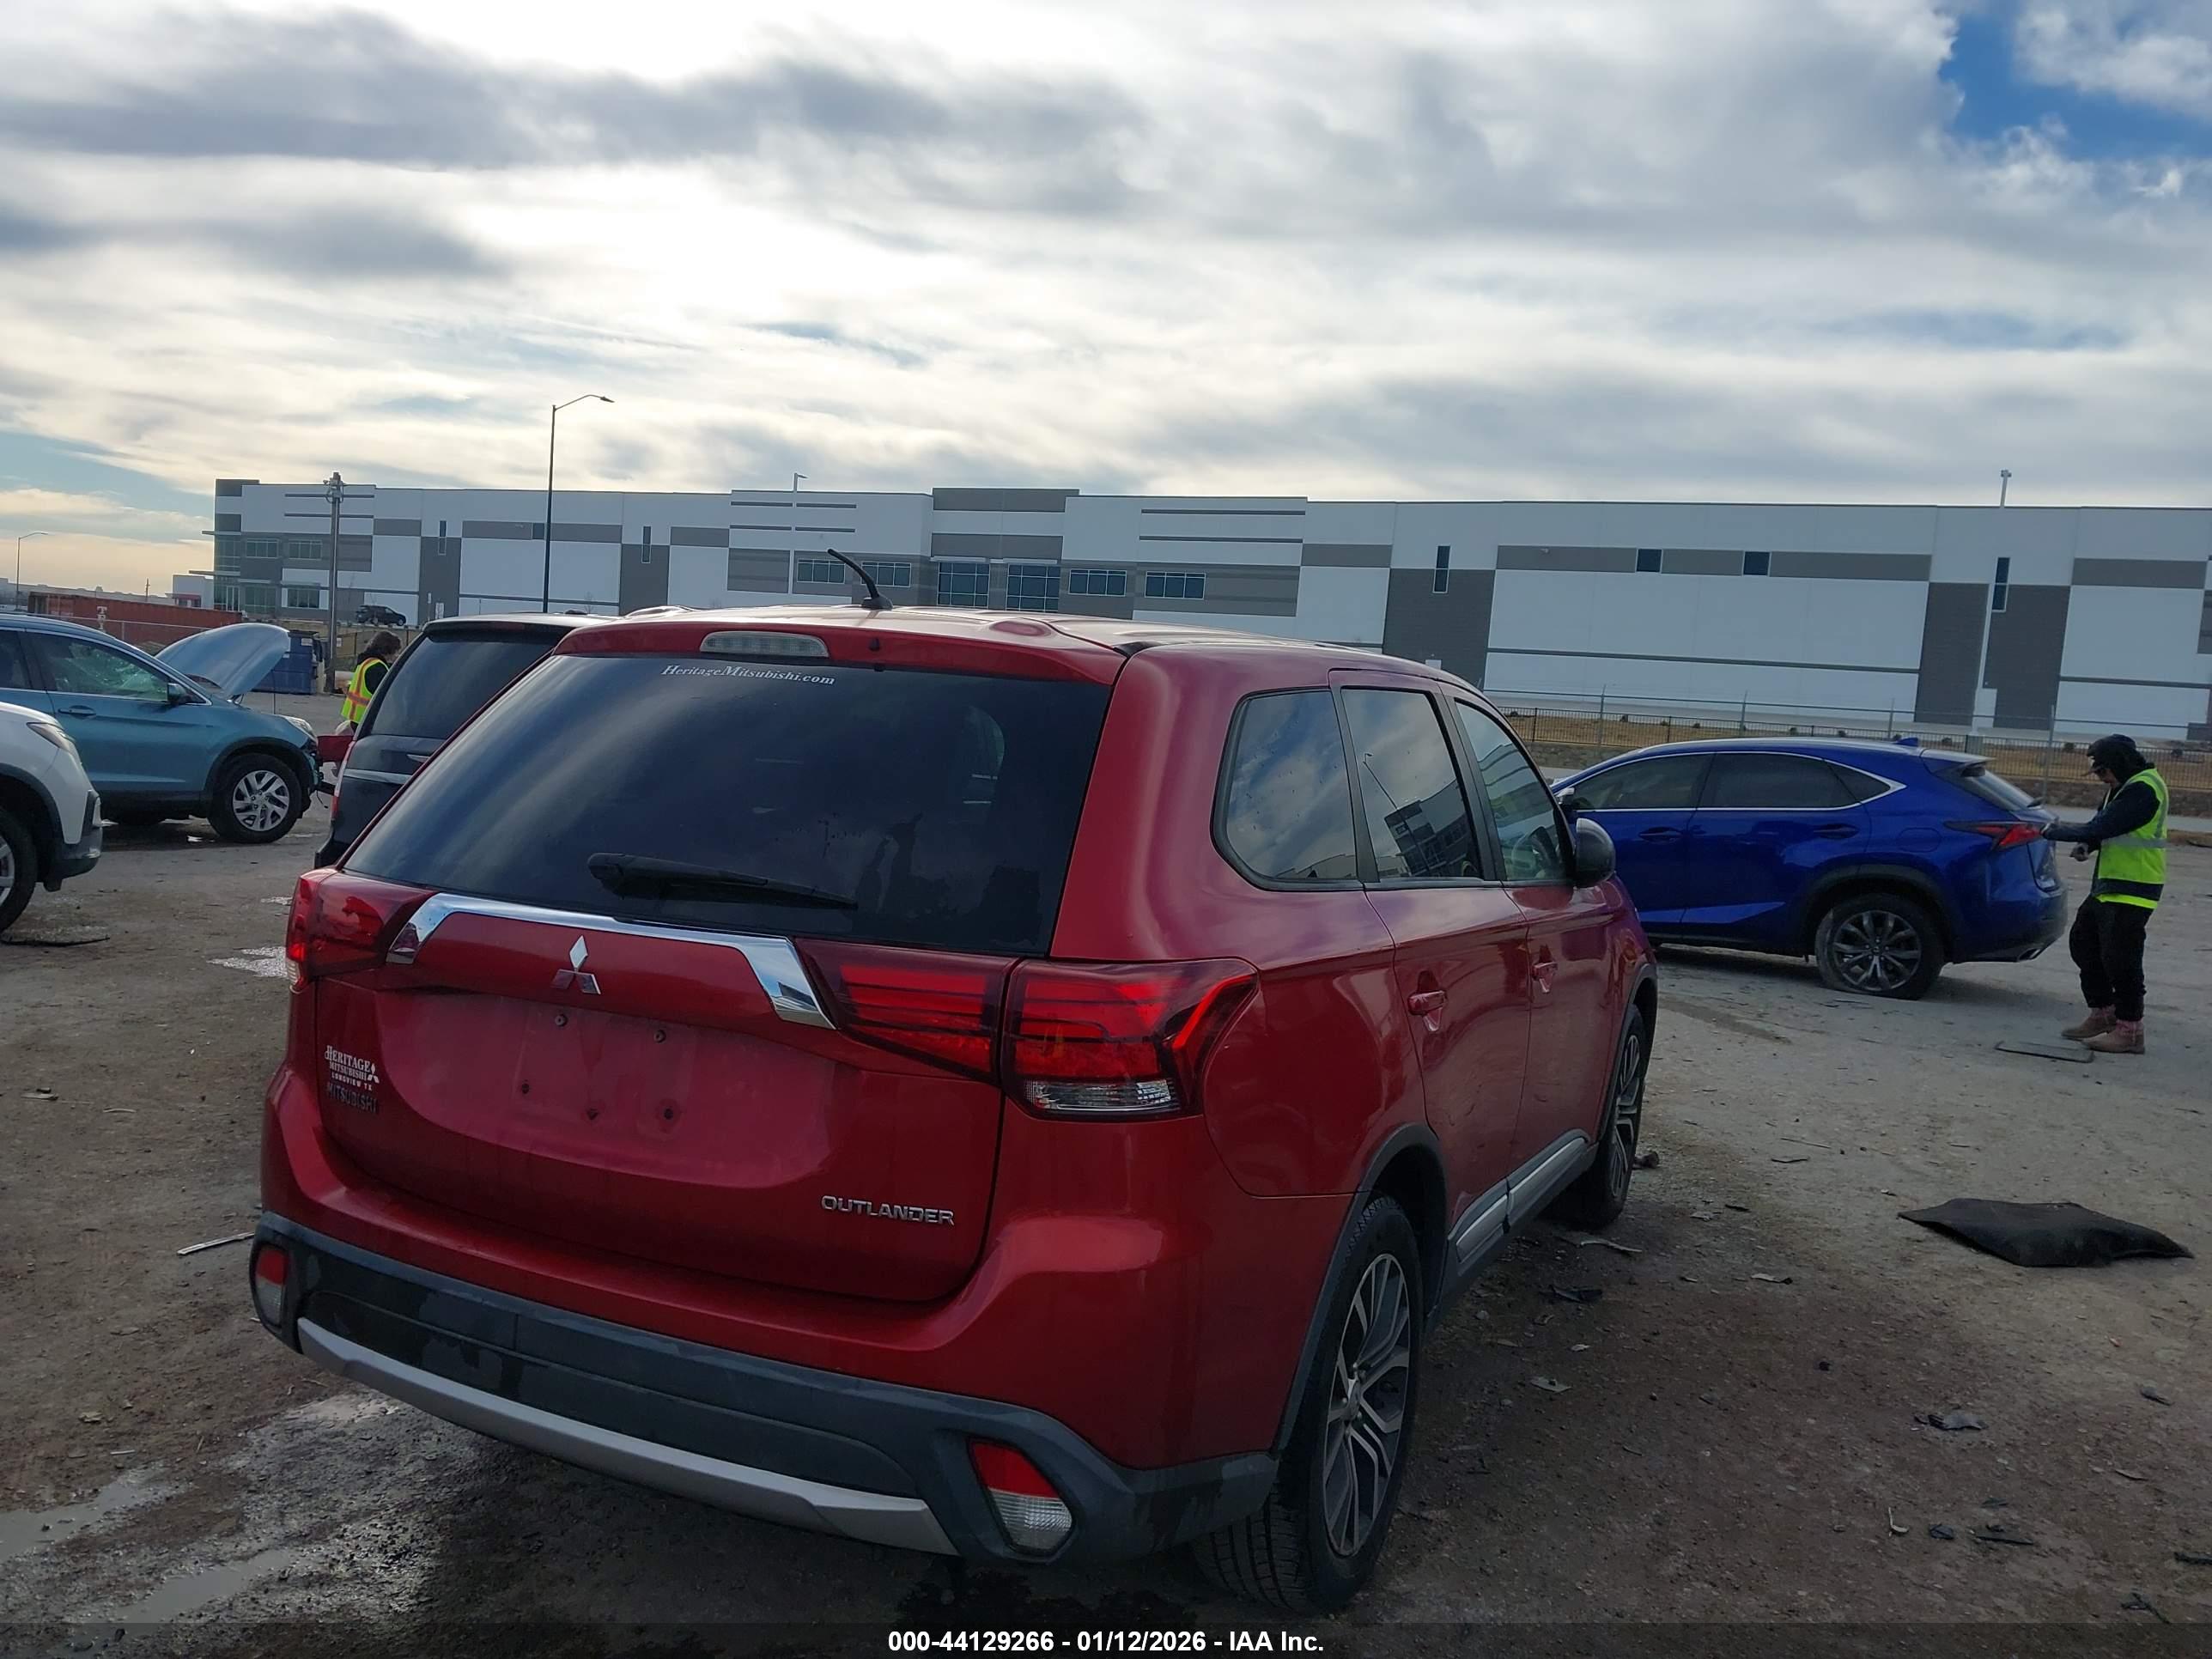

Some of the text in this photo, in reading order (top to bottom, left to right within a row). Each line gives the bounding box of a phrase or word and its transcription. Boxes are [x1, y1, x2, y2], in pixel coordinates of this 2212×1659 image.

[661, 665, 836, 685] HeritageMitsubishi.com
[325, 1045, 371, 1073] HERITAGE
[327, 1083, 377, 1113] MITSUBISHI
[821, 1195, 955, 1226] OUTLANDER
